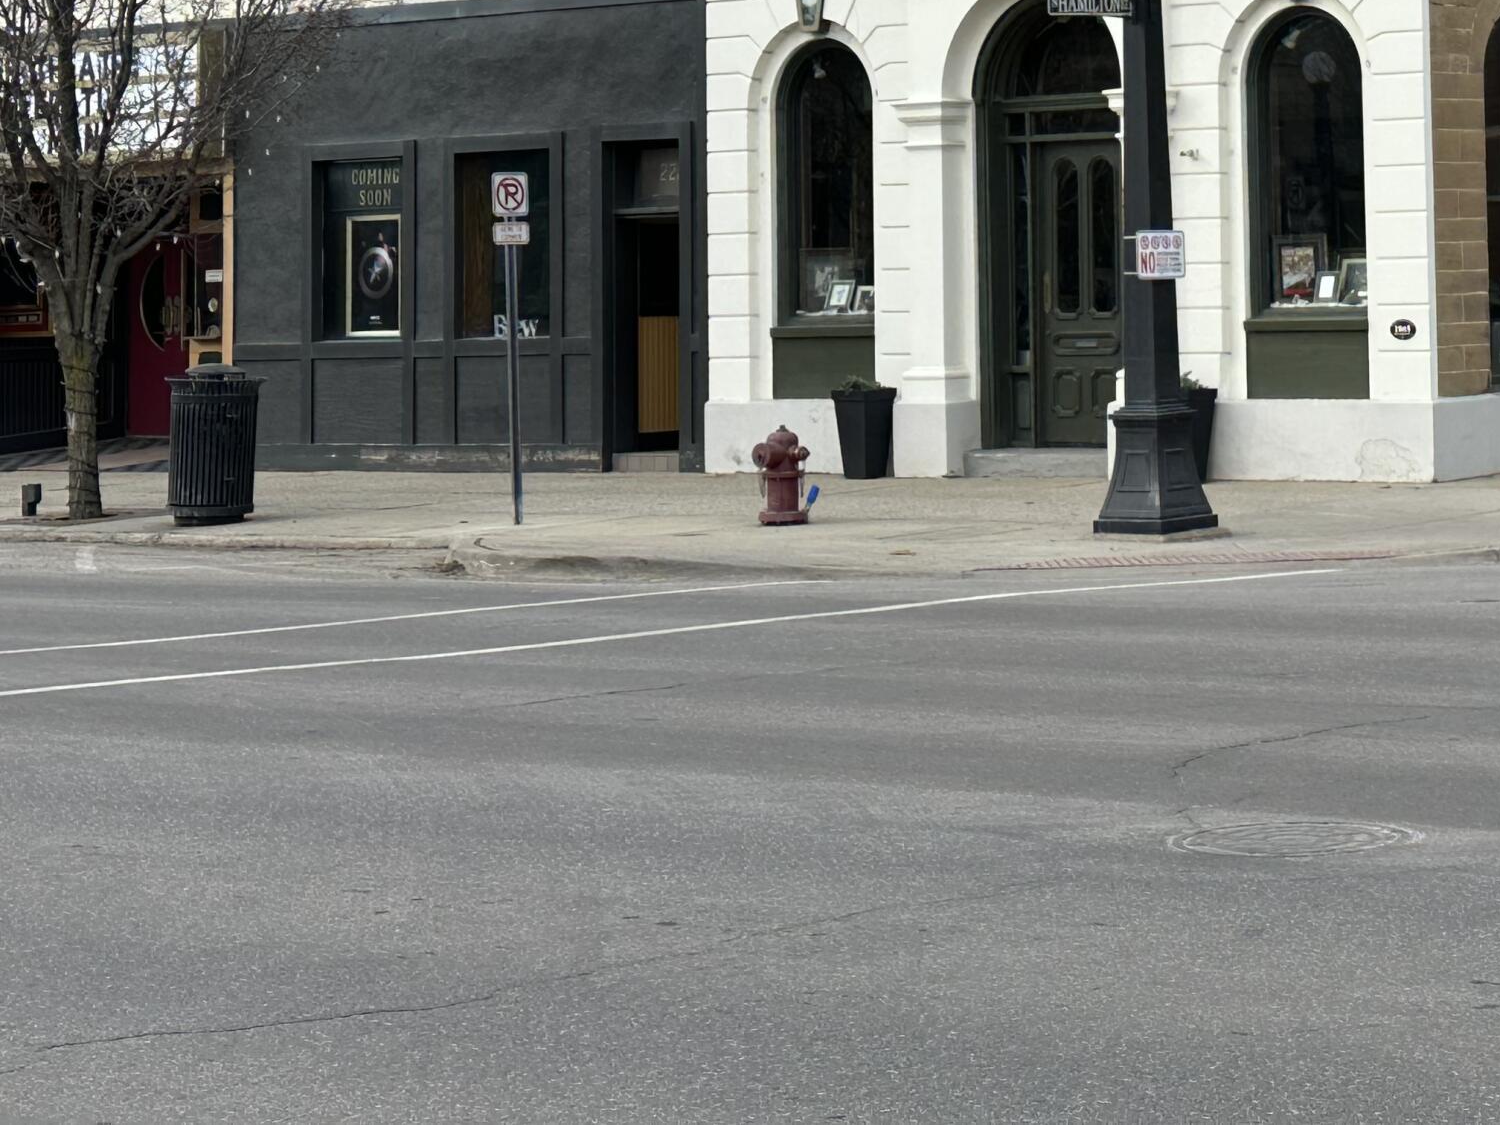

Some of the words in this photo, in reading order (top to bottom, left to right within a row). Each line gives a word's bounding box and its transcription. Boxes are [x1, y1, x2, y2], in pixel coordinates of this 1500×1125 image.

[351, 168, 400, 185] COMING
[359, 188, 392, 206] SOON
[1141, 251, 1155, 274] NO
